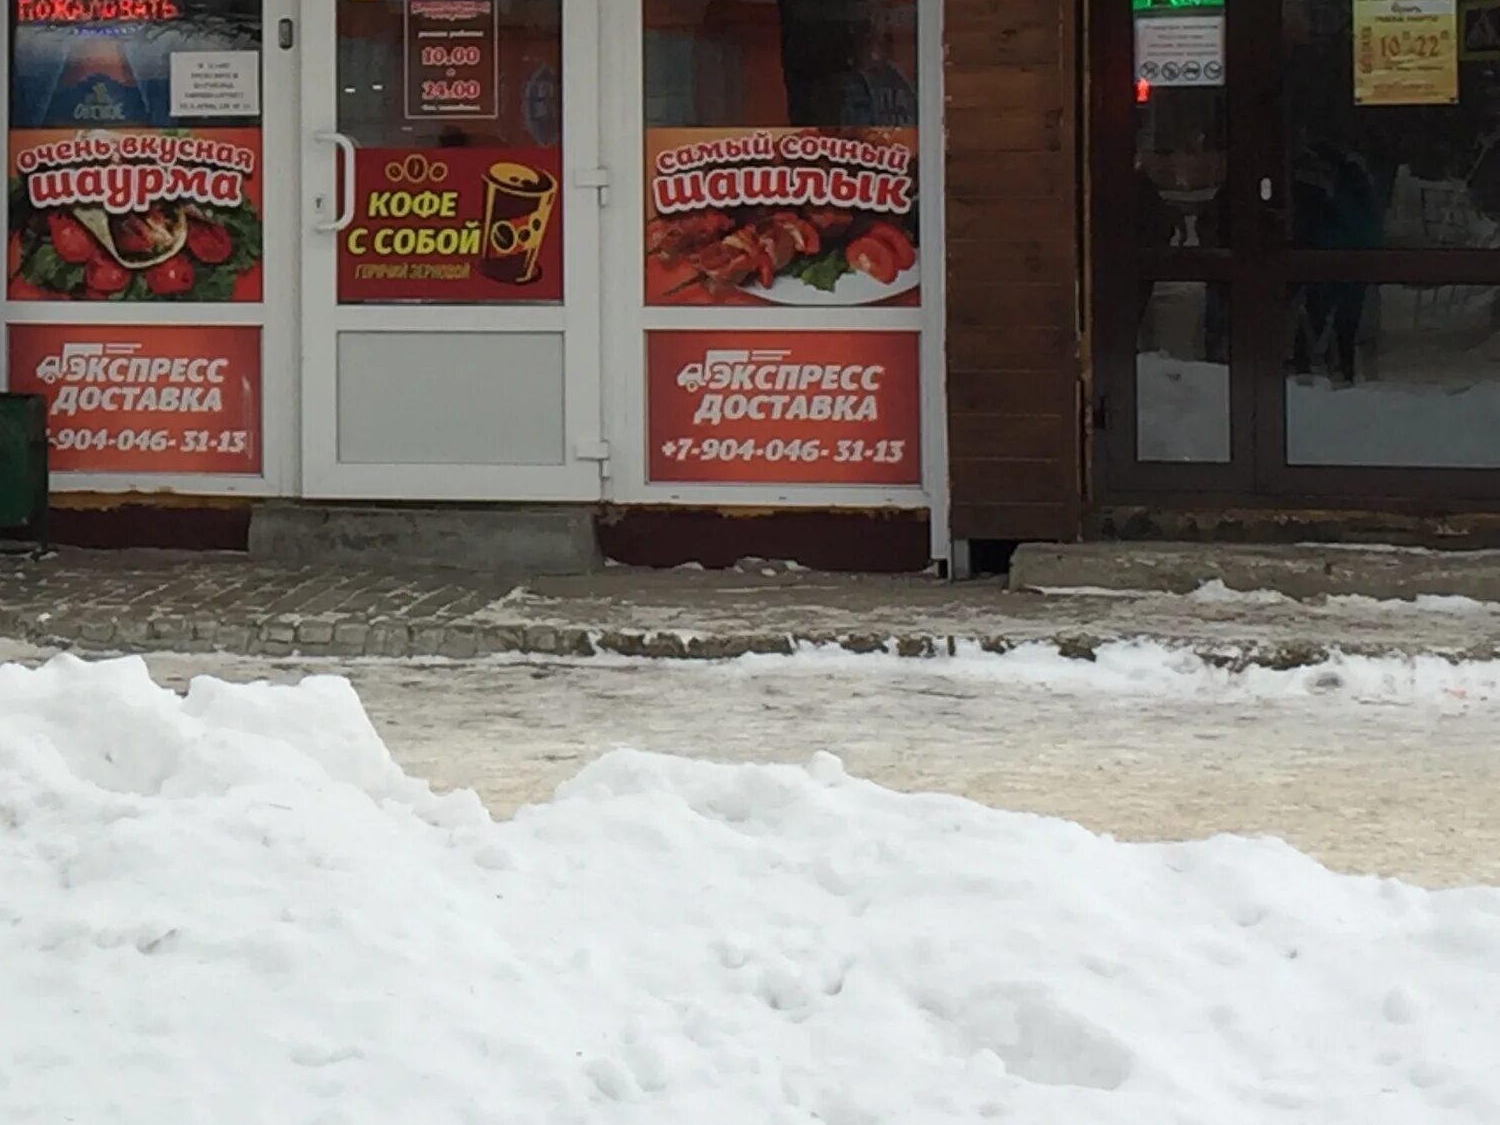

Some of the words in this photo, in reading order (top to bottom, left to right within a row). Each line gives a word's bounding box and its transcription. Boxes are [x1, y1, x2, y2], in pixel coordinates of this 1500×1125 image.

[17, 135, 112, 173] очень
[117, 134, 256, 172] вкусная
[655, 131, 775, 174] самый
[779, 135, 911, 175] сочный
[28, 164, 243, 213] шаурма
[367, 191, 460, 219] КОФЕ
[652, 165, 913, 216] шашлык
[347, 227, 369, 256] С
[373, 221, 482, 256] СОБОЙ
[65, 357, 229, 384] ЭКСПРЕСС
[708, 364, 885, 392] ЭКСПРЕСС
[50, 386, 222, 416] ДОСТАВКА
[693, 394, 878, 425] ДОСТАВКА
